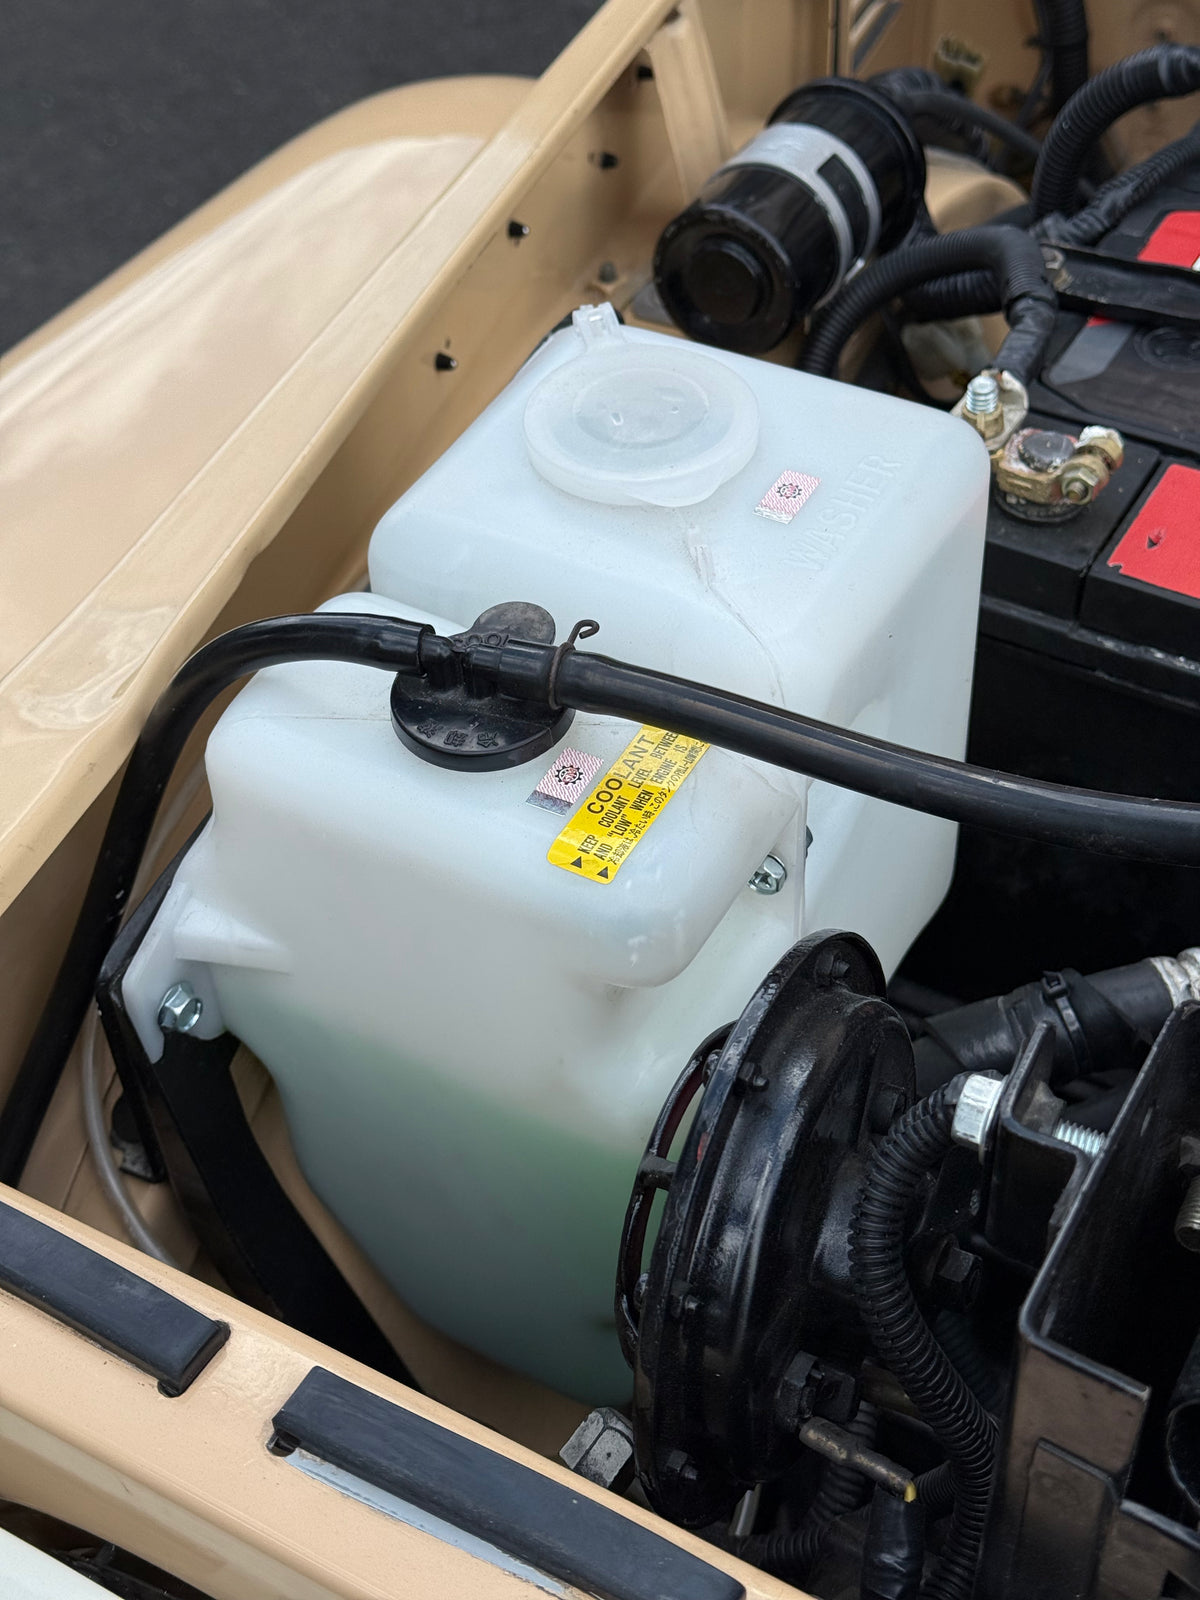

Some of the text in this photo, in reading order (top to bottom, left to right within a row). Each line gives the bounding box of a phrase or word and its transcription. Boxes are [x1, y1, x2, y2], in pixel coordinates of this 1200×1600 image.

[780, 455, 905, 571] WASHER
[577, 731, 680, 855] KEEP COOLANT LEVEL BETWEE
[587, 734, 656, 814] COOLANT
[593, 842, 613, 861] AND
[629, 789, 655, 812] WHEN
[651, 759, 677, 785] ENGINE
[674, 744, 689, 754] IS
